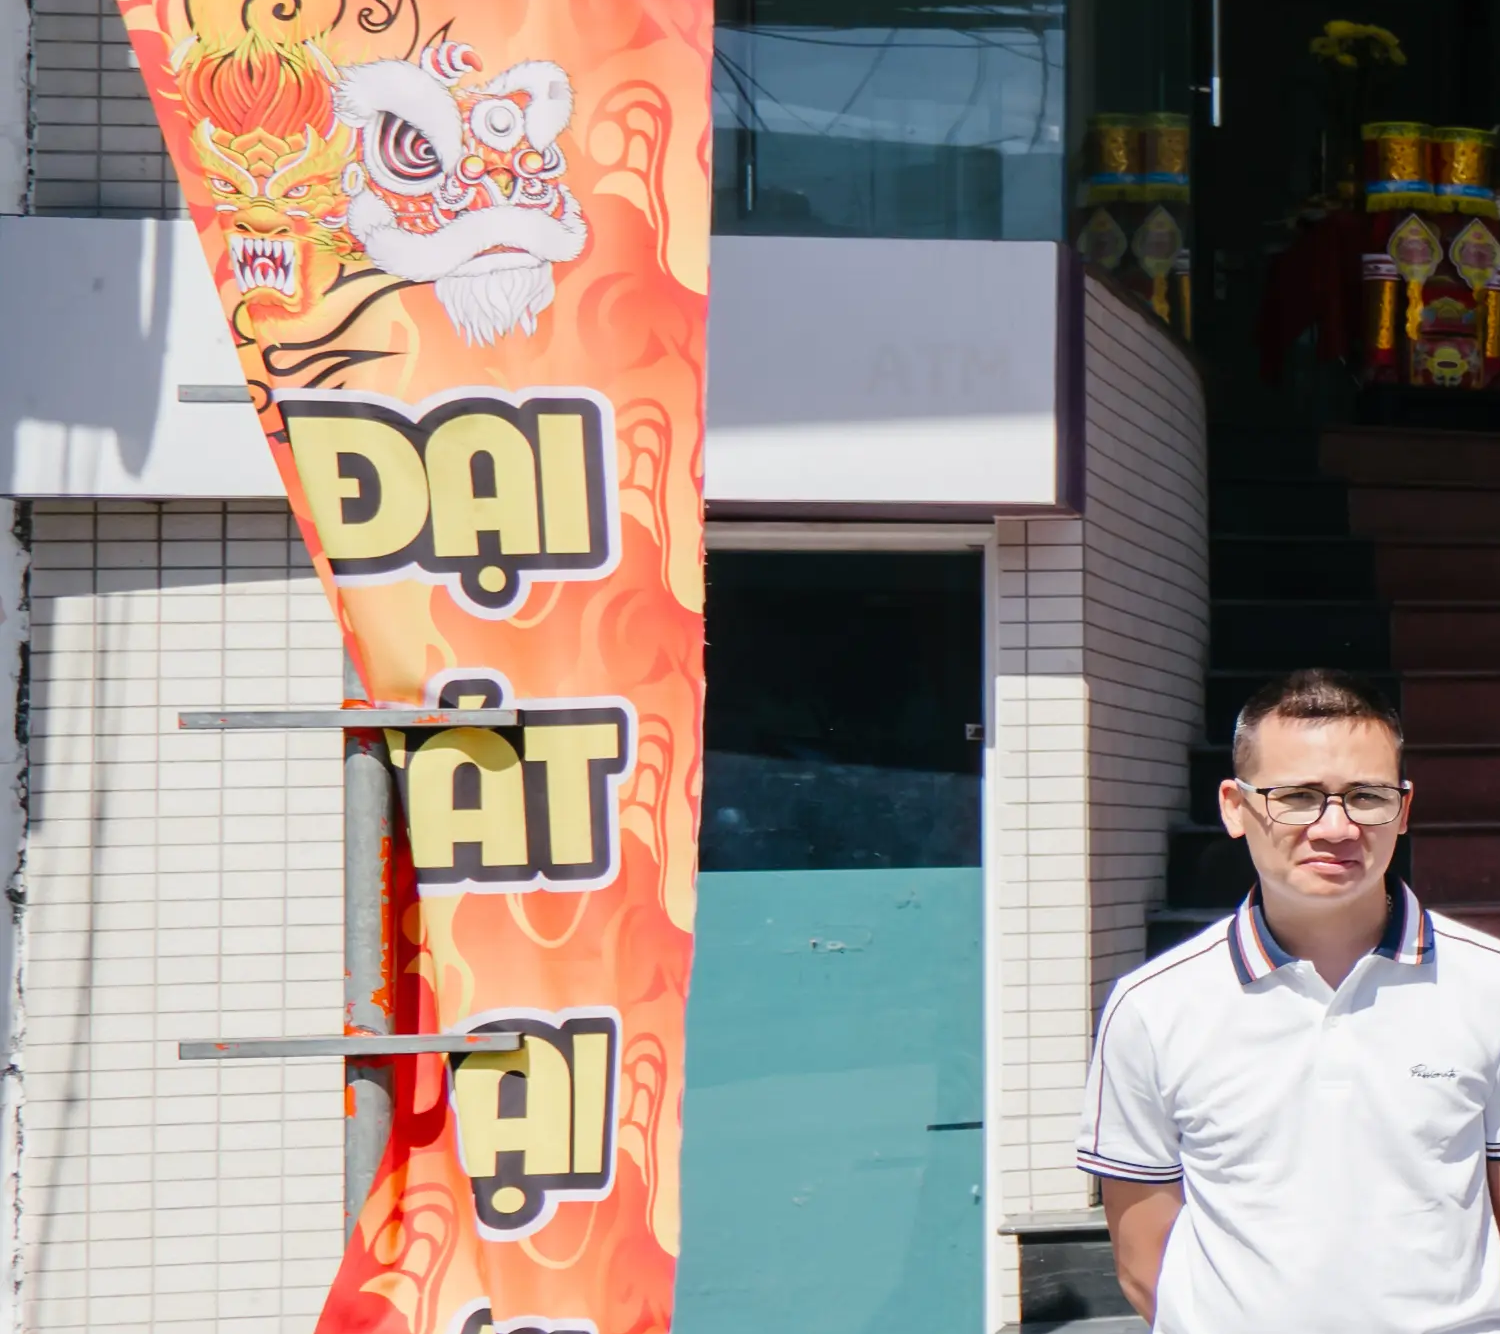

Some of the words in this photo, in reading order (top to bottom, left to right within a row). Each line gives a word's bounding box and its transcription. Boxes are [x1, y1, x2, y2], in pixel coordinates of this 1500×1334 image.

[284, 409, 596, 597] ĐẠI
[386, 691, 622, 871] ÁT
[452, 1027, 610, 1216] ẠI
